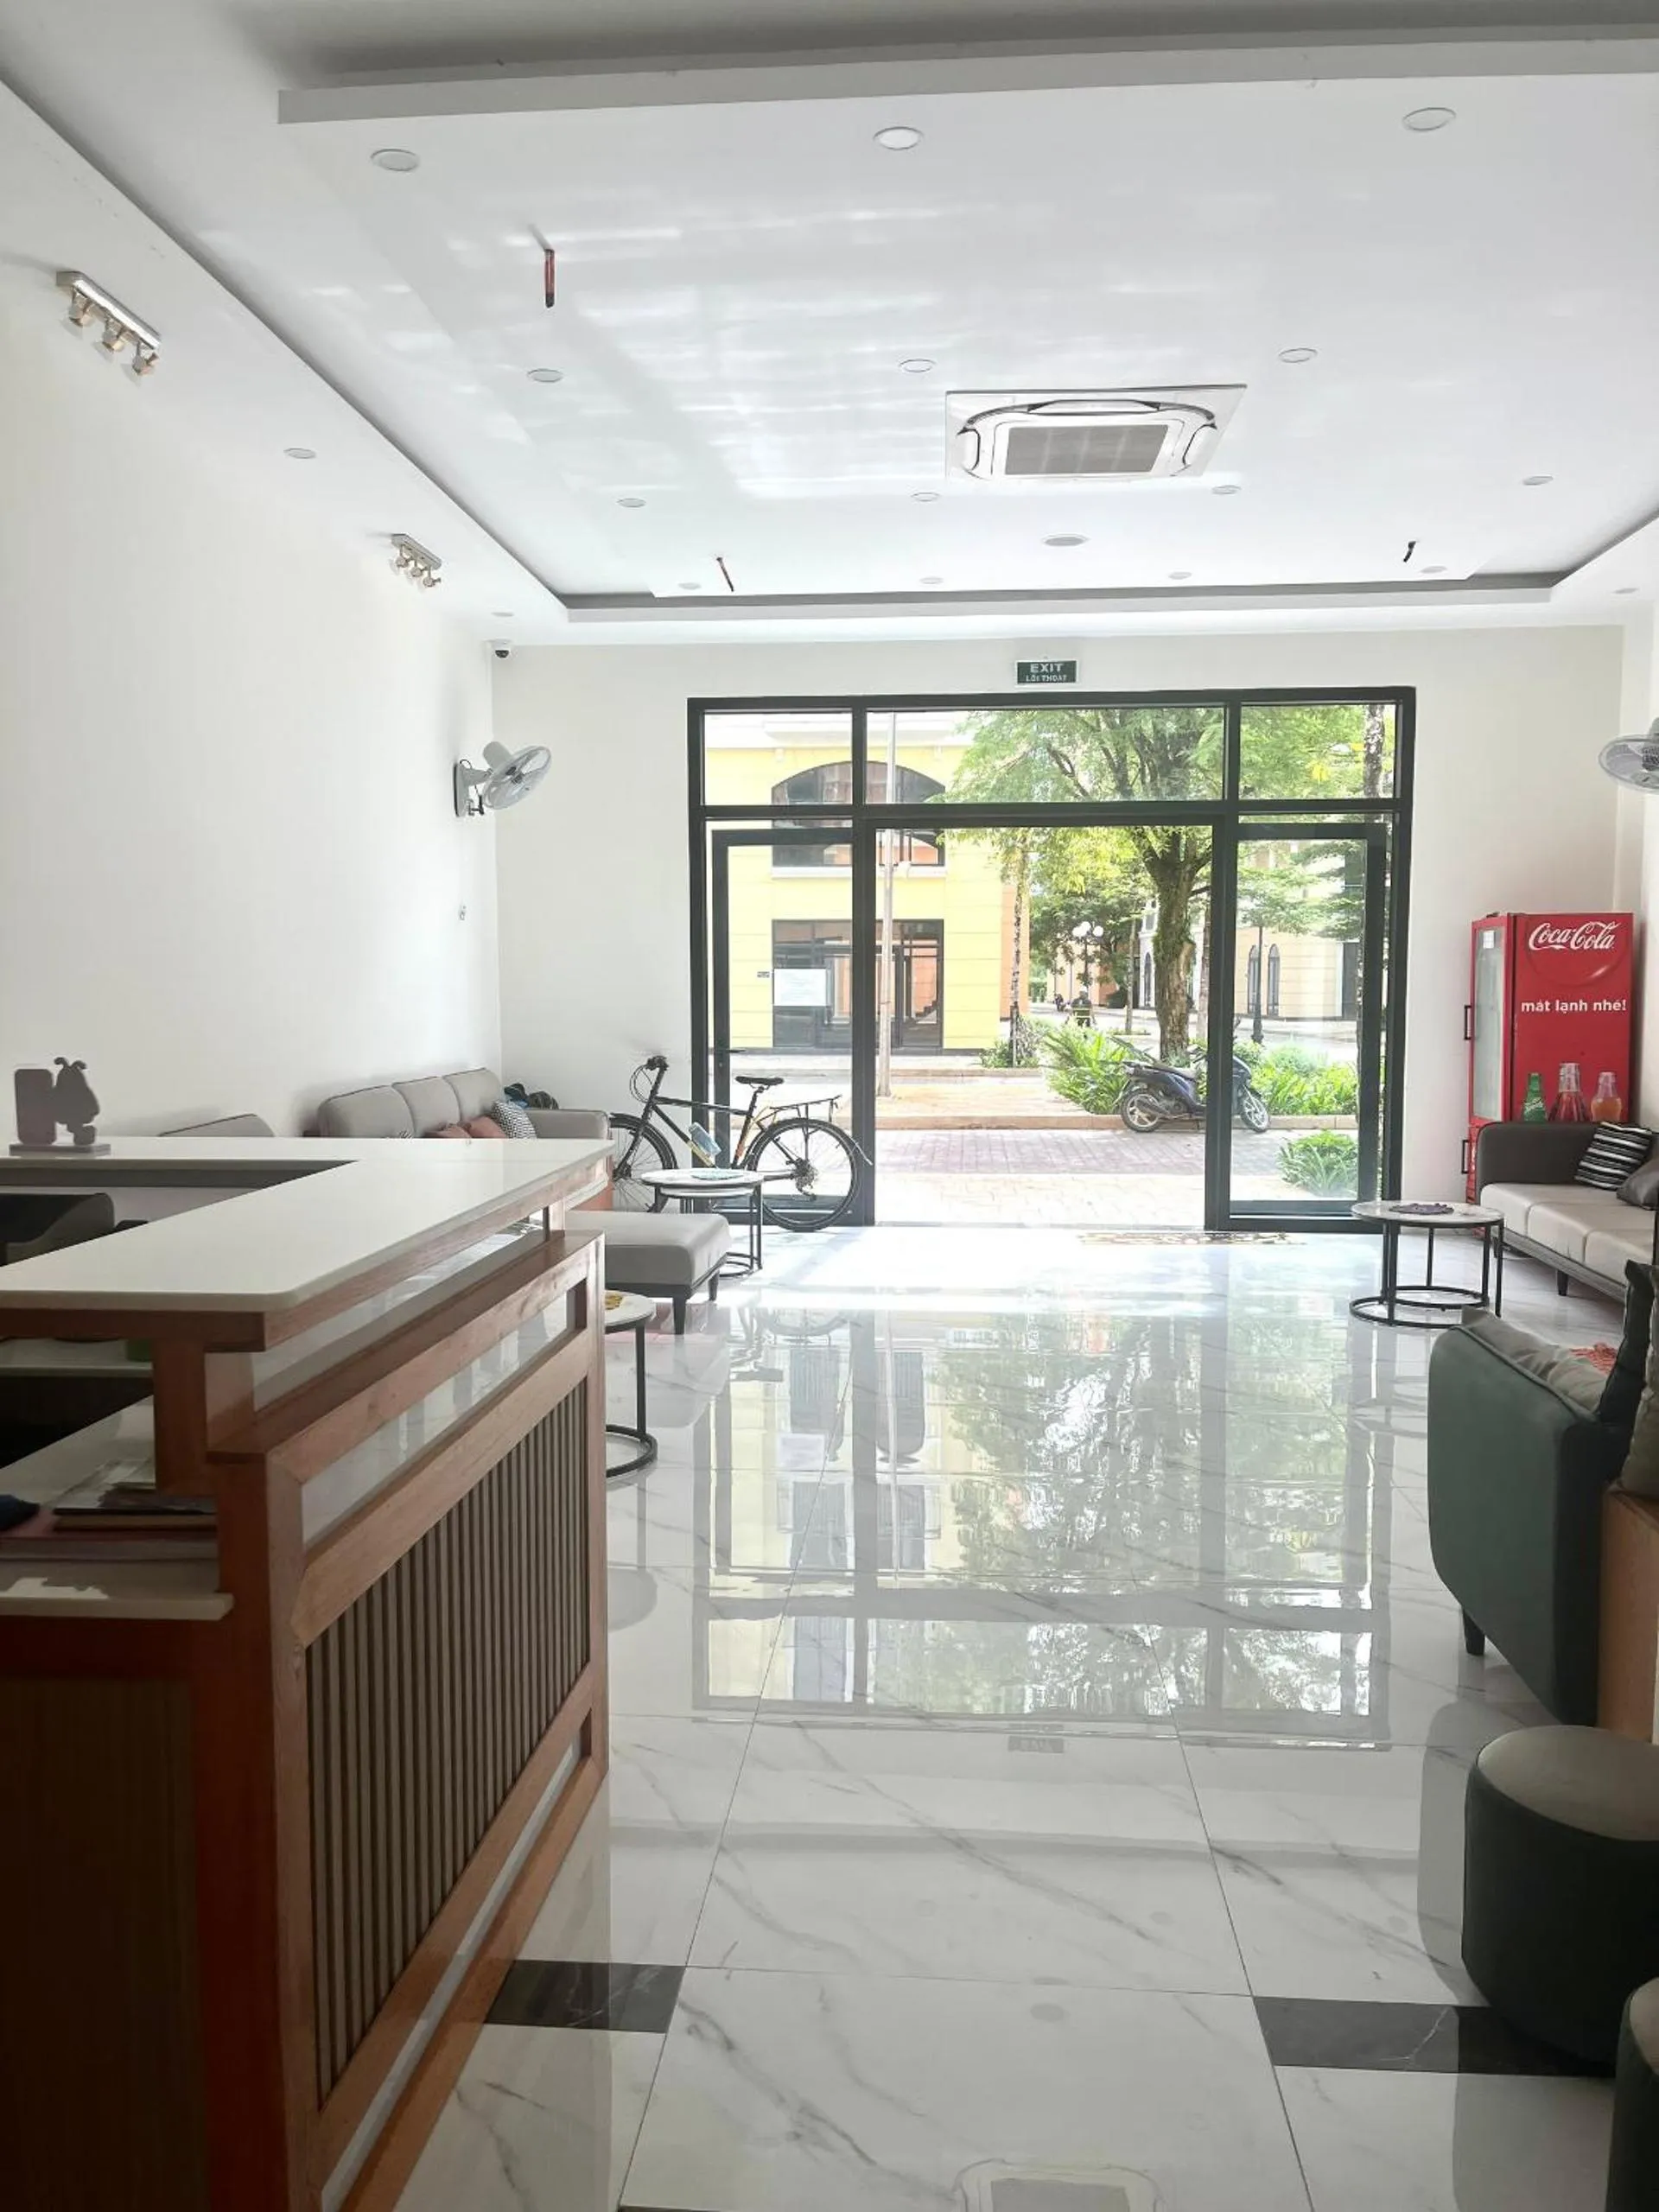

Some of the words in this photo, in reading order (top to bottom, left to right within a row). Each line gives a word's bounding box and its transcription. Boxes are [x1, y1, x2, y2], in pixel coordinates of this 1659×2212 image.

[1030, 663, 1064, 673] EXIT
[1529, 921, 1621, 950] Coca-Cola
[1555, 999, 1588, 1014] lạnh
[1593, 999, 1627, 1012] nhé!
